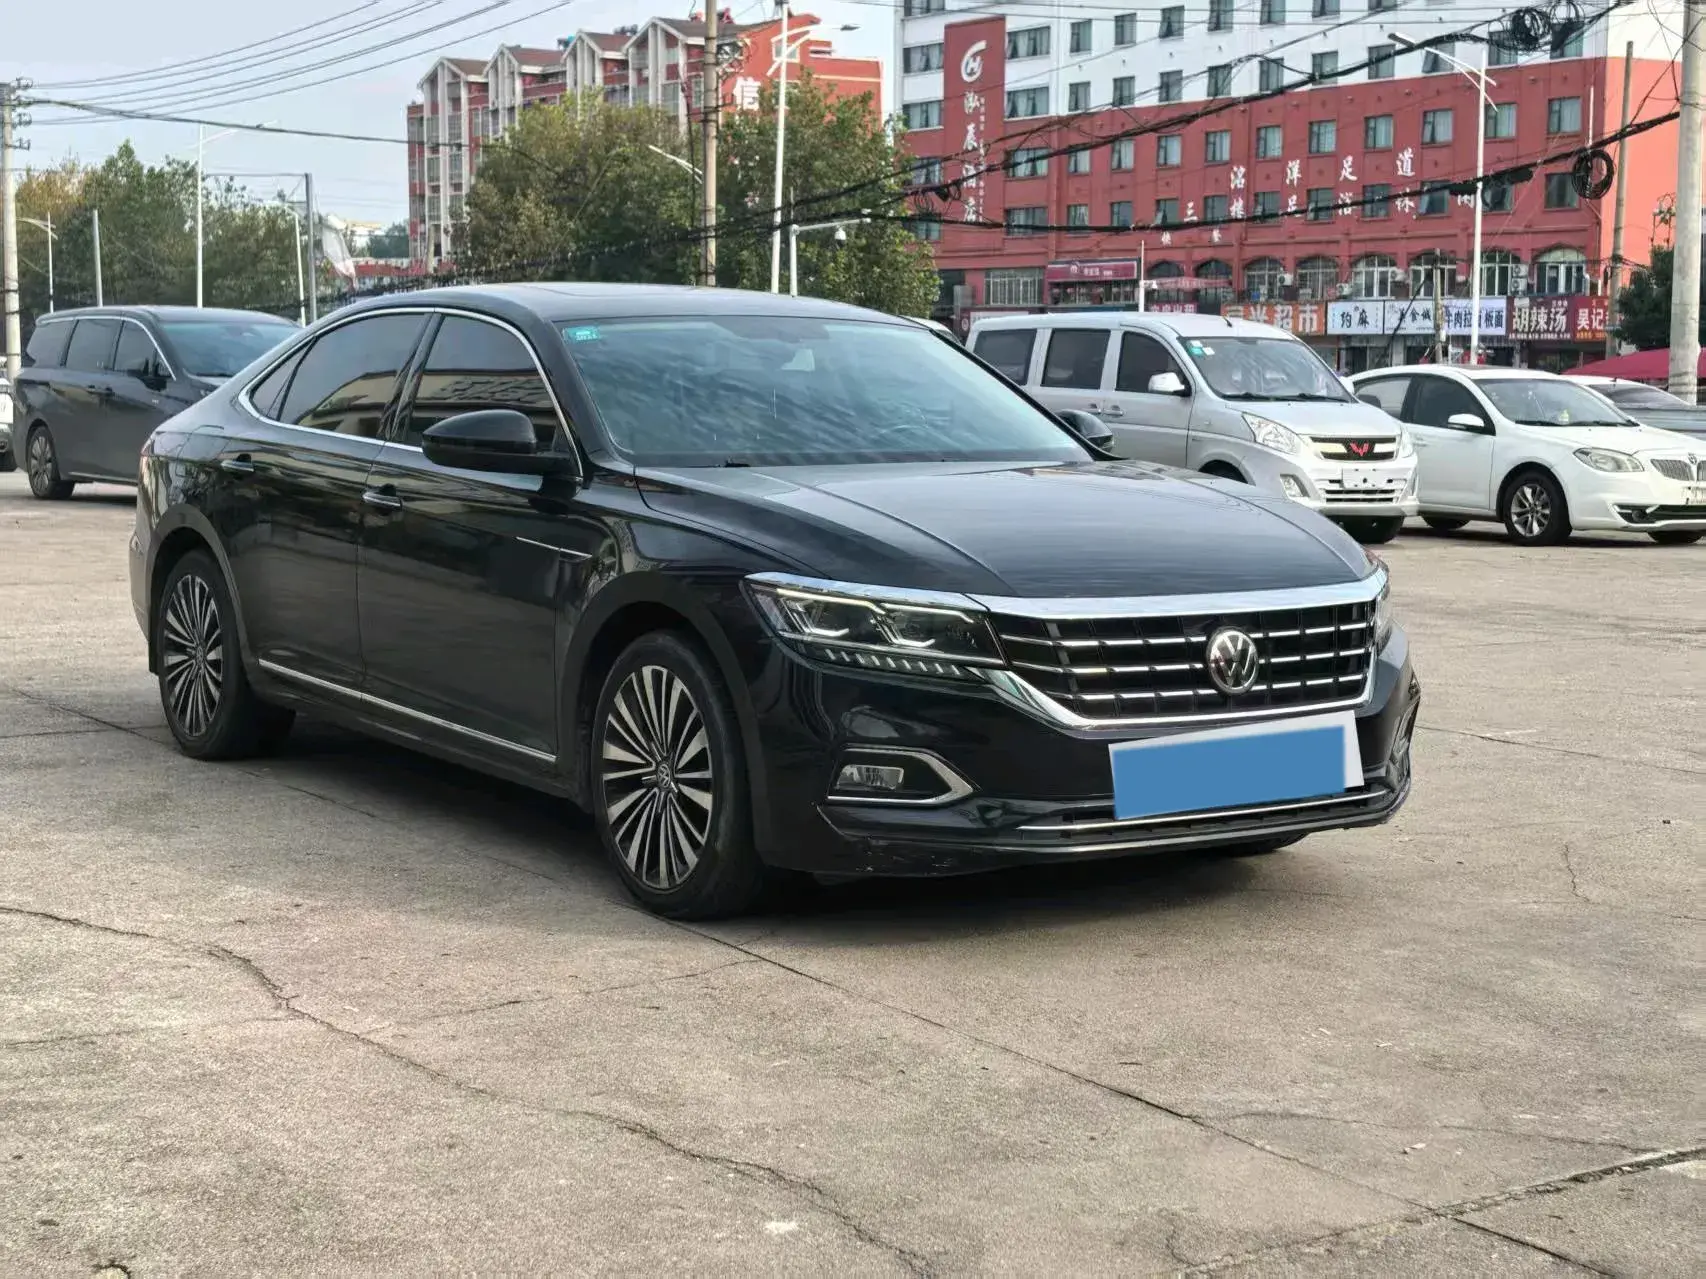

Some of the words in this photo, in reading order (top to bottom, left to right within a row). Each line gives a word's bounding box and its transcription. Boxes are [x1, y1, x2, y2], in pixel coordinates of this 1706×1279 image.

[1444, 305, 1504, 329] 牛肉拉板面
[1512, 306, 1567, 333] 胡辣汤
